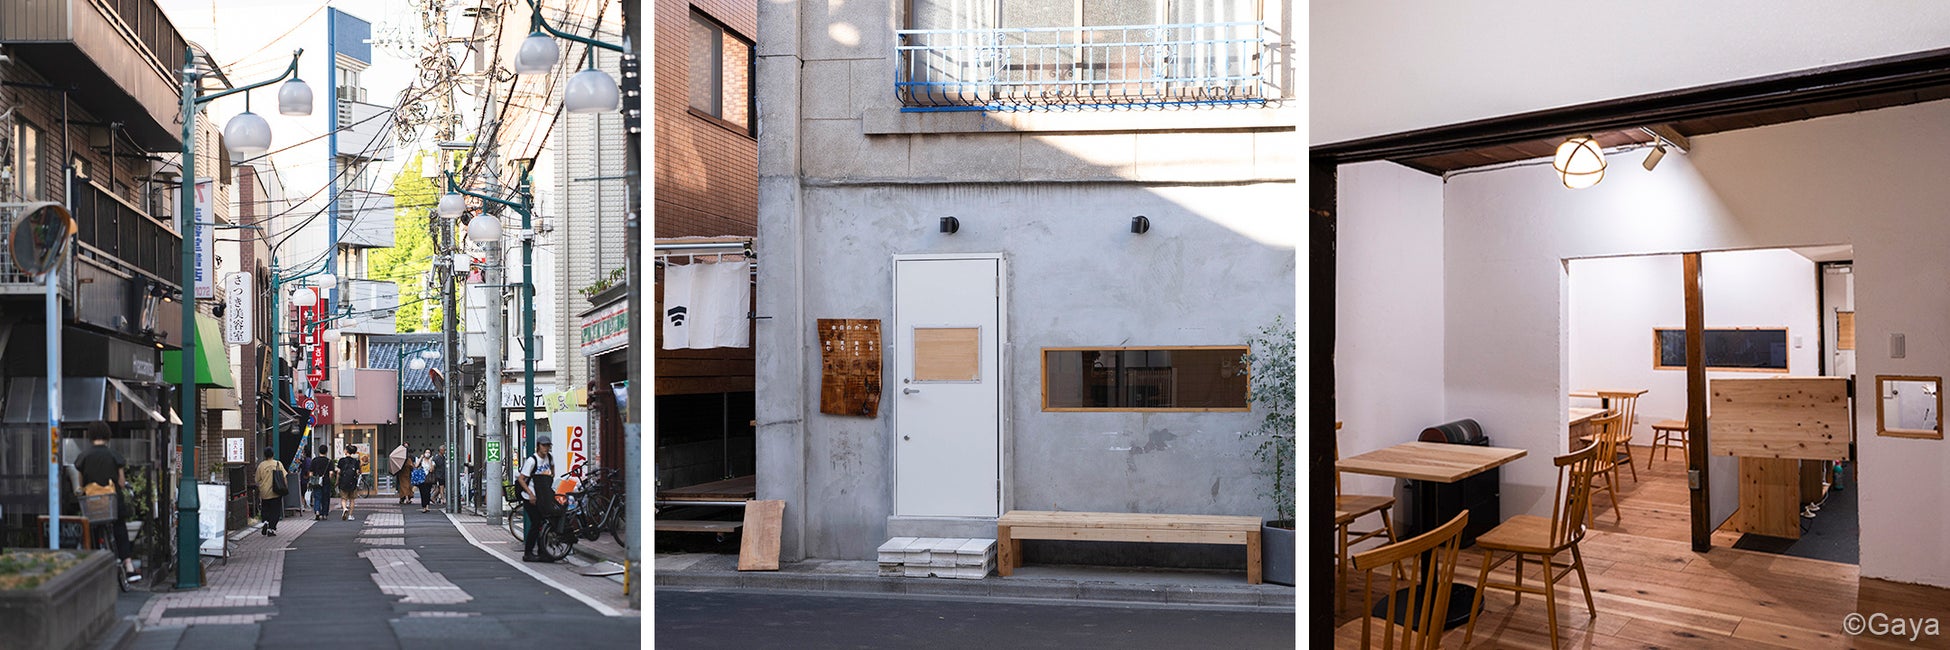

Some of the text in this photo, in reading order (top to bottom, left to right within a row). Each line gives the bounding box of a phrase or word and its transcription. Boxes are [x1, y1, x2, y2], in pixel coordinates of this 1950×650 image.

[233, 275, 244, 341] さつき美容室
[571, 426, 586, 477] DyDo
